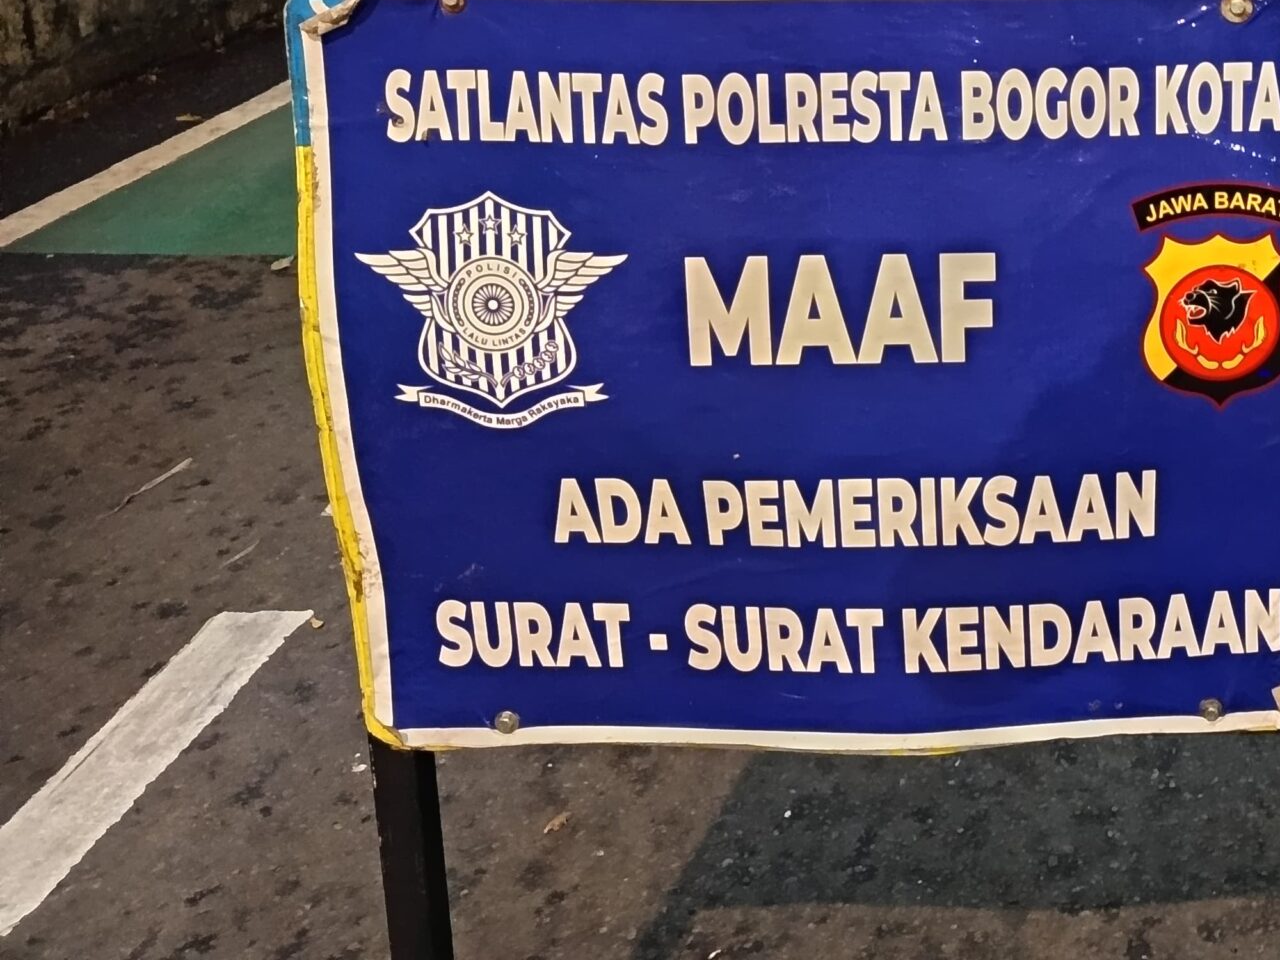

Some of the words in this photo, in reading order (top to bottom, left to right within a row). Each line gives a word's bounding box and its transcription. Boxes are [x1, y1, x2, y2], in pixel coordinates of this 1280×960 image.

[385, 69, 668, 145] SATLANTAS
[682, 71, 948, 145] POLRESTA
[961, 67, 1140, 141] BOGOR
[1146, 193, 1208, 222] JAWA
[465, 263, 517, 278] POLISI
[685, 253, 996, 366] MAAF
[463, 327, 488, 345] LALU
[492, 328, 526, 347] LINTAS
[423, 394, 493, 424] Dharmakerta
[496, 416, 528, 427] Marga
[528, 395, 580, 419] Raksyaka
[555, 473, 690, 548] ADA
[703, 470, 1157, 548] PEMERIKSAAN
[436, 600, 630, 668] SURAT
[685, 604, 883, 674] SURAT
